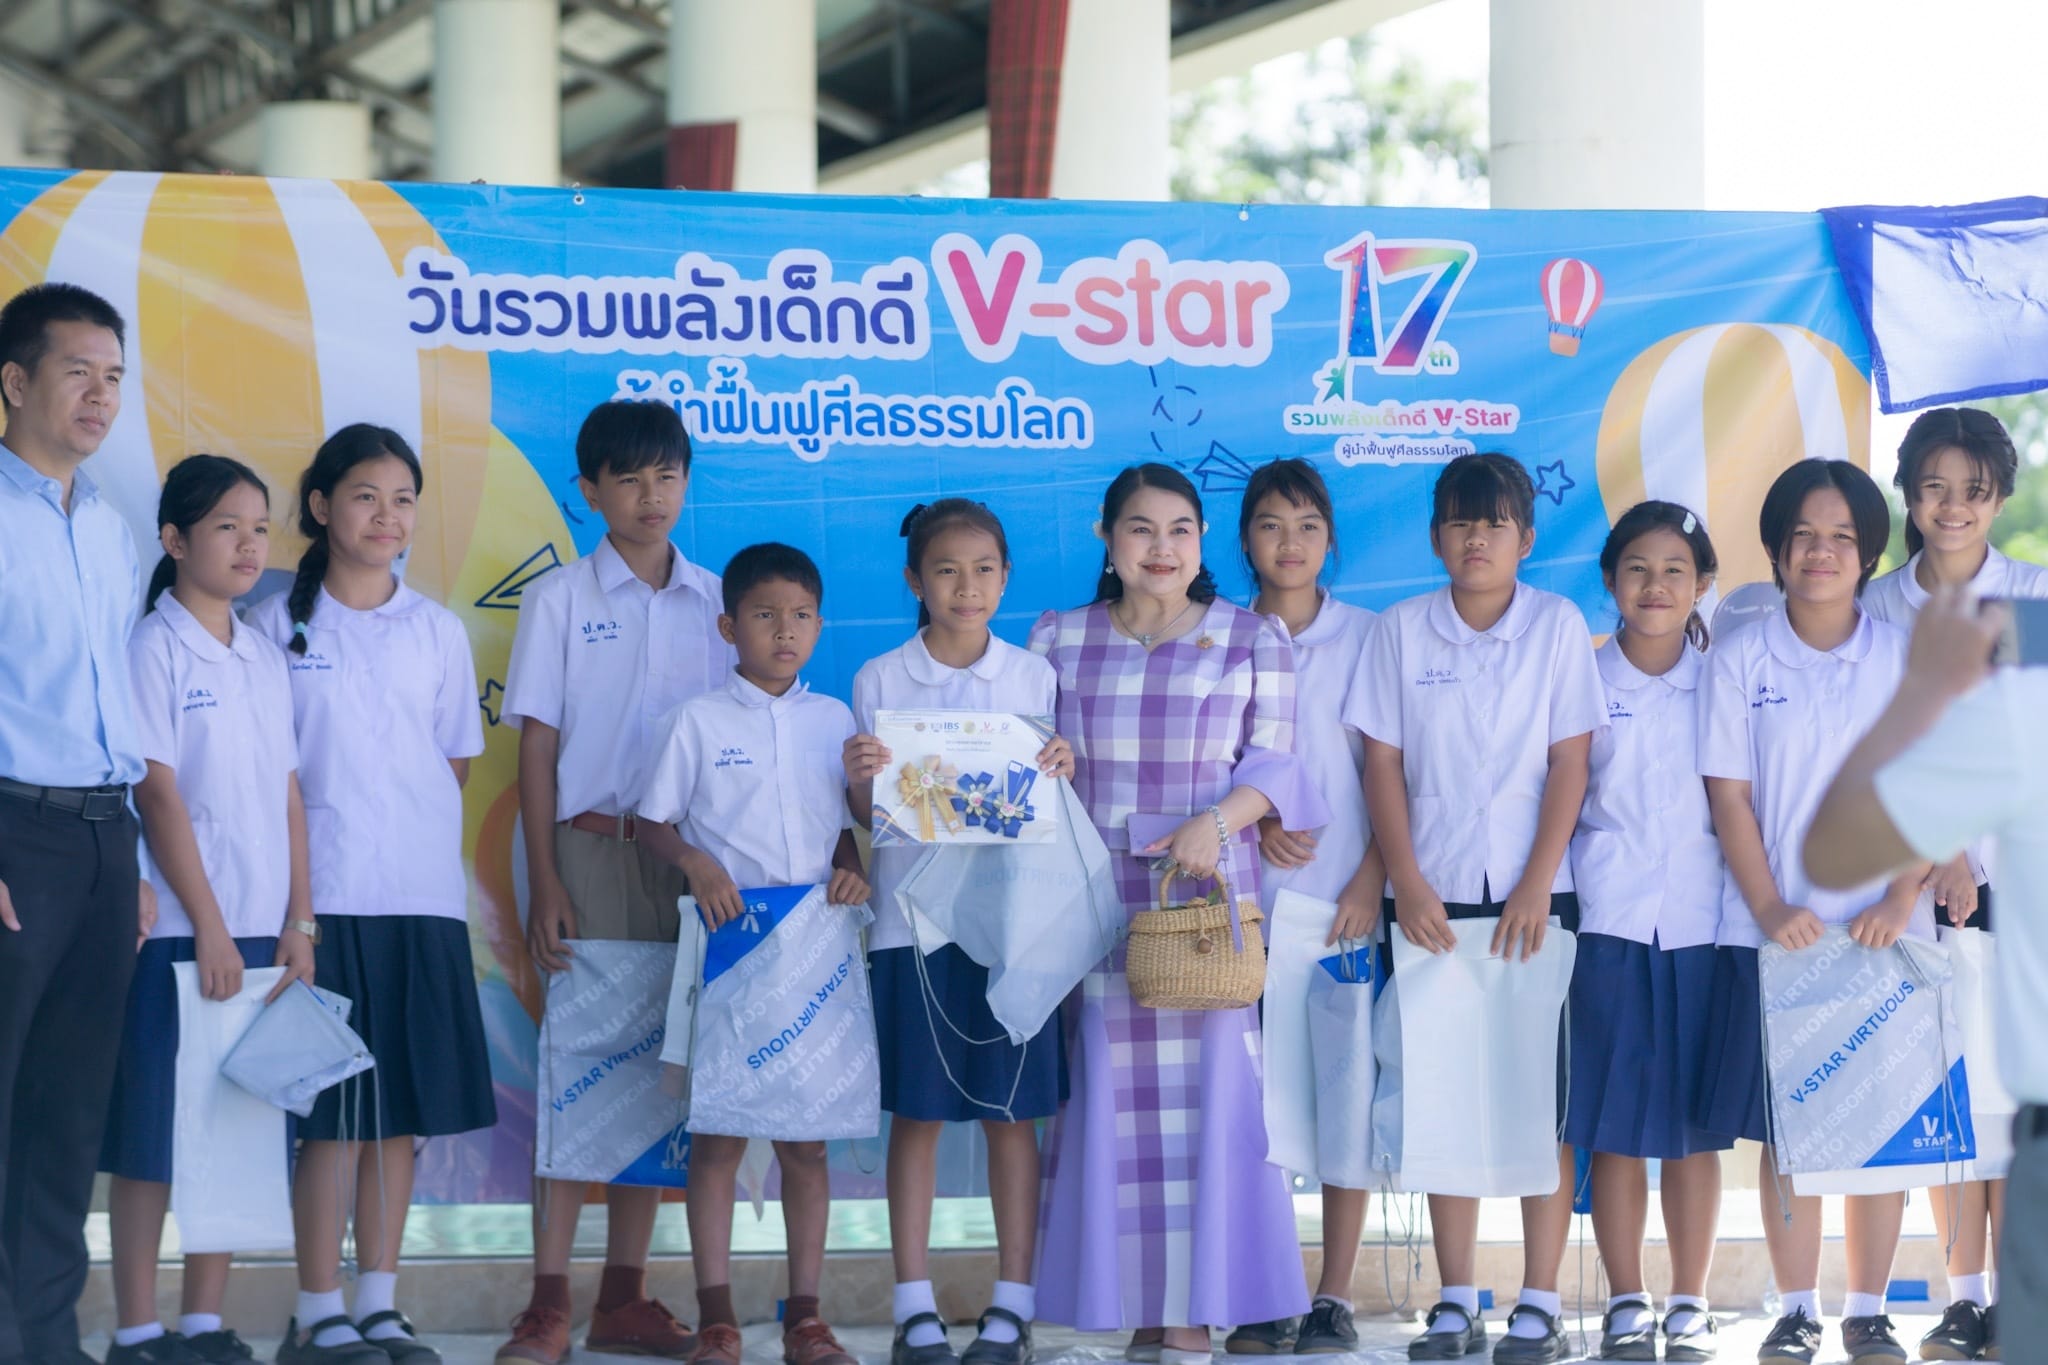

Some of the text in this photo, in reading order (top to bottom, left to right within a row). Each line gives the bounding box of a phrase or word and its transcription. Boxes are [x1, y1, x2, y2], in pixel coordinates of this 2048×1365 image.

[408, 250, 1270, 348] วันรวมพลังเด็กดี V-star
[1291, 407, 1512, 427] รวมพลังเด็กดี V-Star
[547, 959, 634, 1024] VIRTUOUS
[1791, 963, 1874, 1044] MORALITY
[1858, 969, 1900, 1010] 3TO1
[747, 1000, 821, 1070] VIRTUOUS
[1789, 980, 1914, 1104] V-STAR VIRTUOUS
[551, 1066, 605, 1112] V-STAR
[803, 1045, 876, 1121] VIRTUOUS
[1899, 1070, 1938, 1110] CAMP
[1811, 1131, 1850, 1168] 3TO1
[1922, 1115, 1939, 1137] V
